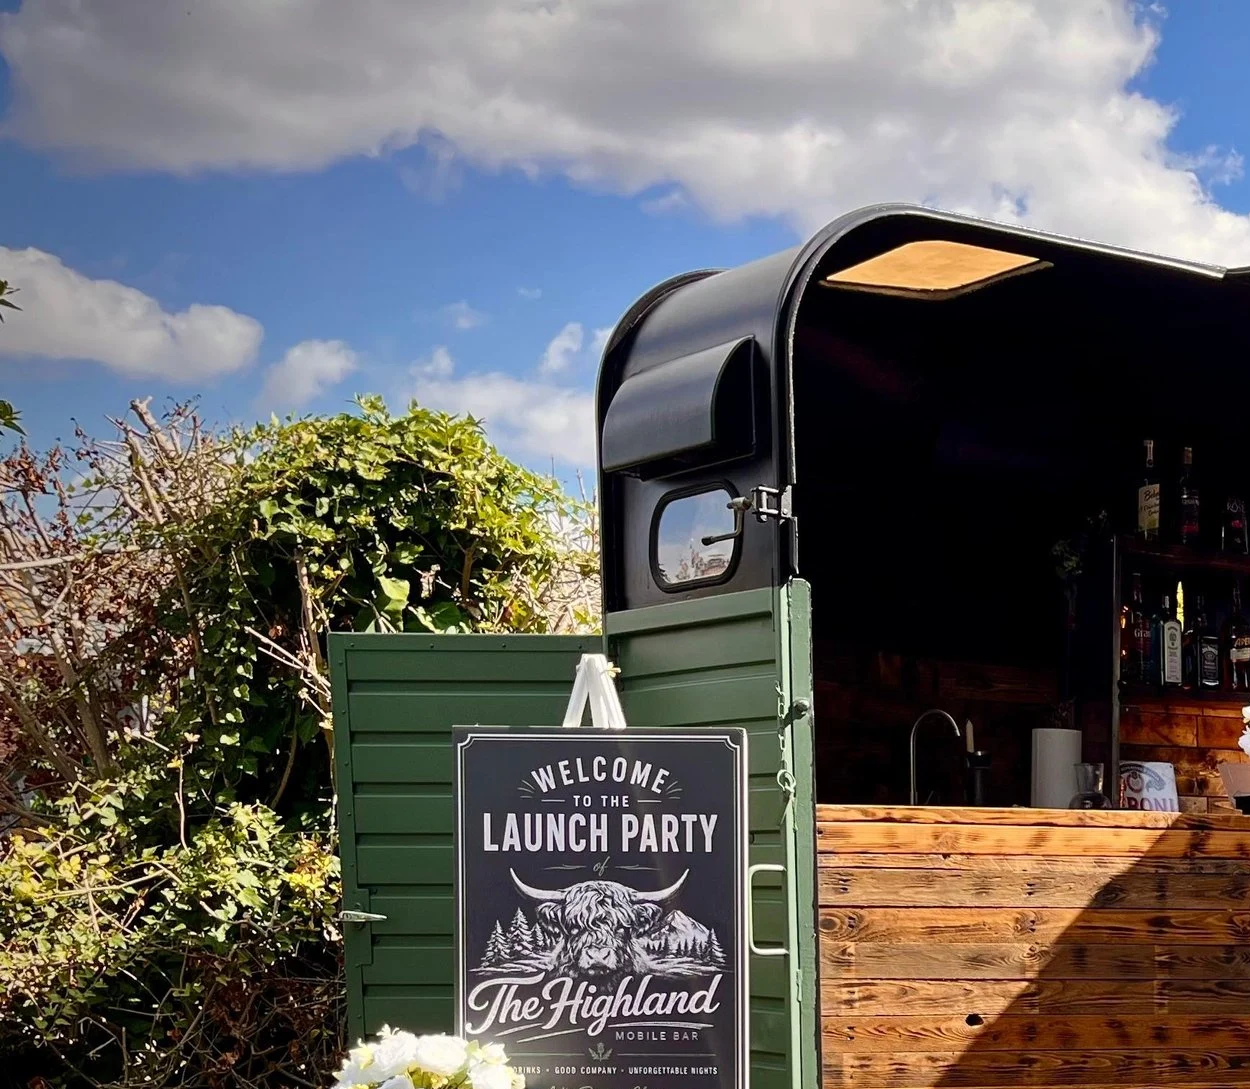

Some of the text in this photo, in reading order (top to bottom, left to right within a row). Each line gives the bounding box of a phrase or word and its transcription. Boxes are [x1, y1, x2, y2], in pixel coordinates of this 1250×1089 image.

[531, 755, 670, 793] WELCOME
[573, 795, 629, 808] TO THE
[483, 812, 718, 853] LAUNCH PARTY
[592, 856, 611, 877] of
[465, 972, 720, 1036] The Highland
[615, 1031, 699, 1041] MOBILE BAR
[554, 1066, 577, 1075] GOOD
[580, 1066, 617, 1075] COMPANY
[628, 1066, 688, 1075] UNFORGETTABLE
[691, 1066, 718, 1075] NIGHTS
